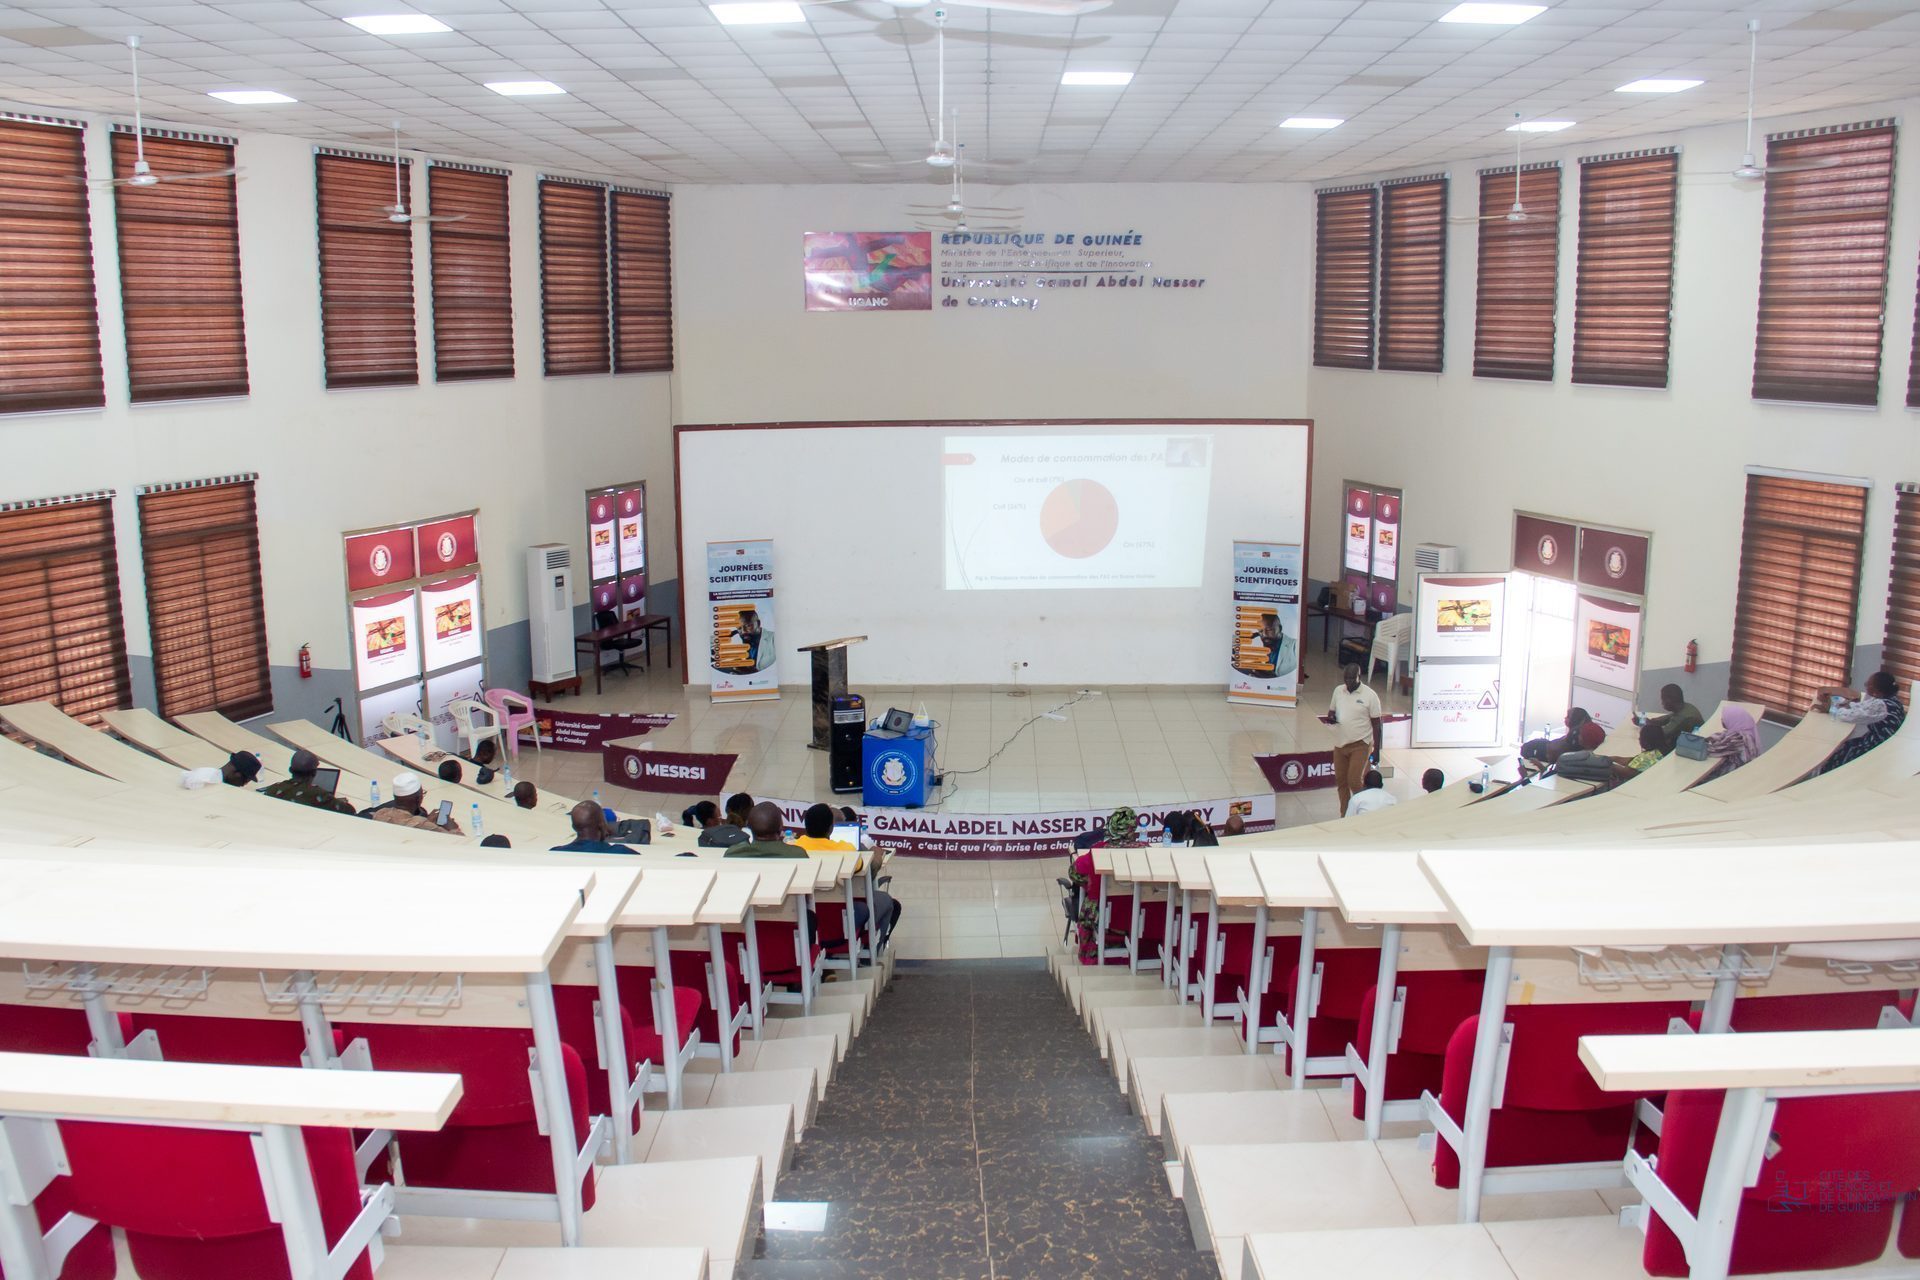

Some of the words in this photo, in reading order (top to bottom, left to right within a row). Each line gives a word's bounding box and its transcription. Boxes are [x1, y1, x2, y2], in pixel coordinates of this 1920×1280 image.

[1054, 234, 1075, 245] DE
[1082, 230, 1142, 246] GUINÉE
[986, 249, 997, 257] de
[941, 260, 952, 268] de
[954, 260, 964, 268] la
[1074, 260, 1084, 268] et
[1086, 260, 1098, 268] de
[1036, 276, 1088, 288] Gamal
[1096, 276, 1143, 288] Abdel
[1152, 276, 1206, 288] Nasser
[848, 297, 889, 306] UGANC
[942, 295, 958, 307] de
[1000, 454, 1034, 464] Modes
[1037, 454, 1050, 464] de
[1053, 453, 1128, 464] consommation
[1130, 453, 1148, 462] des
[718, 562, 764, 573] JOURNÉES
[1243, 566, 1288, 576] JOURNÉES
[710, 573, 772, 584] SCIENTIFIQUES
[1234, 576, 1298, 586] SCIENTIFIQUES
[645, 762, 706, 780] MESRSI
[874, 816, 942, 834] GAMAL
[944, 820, 1007, 835] ABDEL
[1012, 817, 1087, 835] NASSER
[880, 840, 912, 850] savoir,
[918, 841, 943, 850] c'est
[946, 842, 958, 851] ici
[960, 844, 980, 853] que
[1005, 842, 1031, 852] brise
[1033, 842, 1048, 851] les
